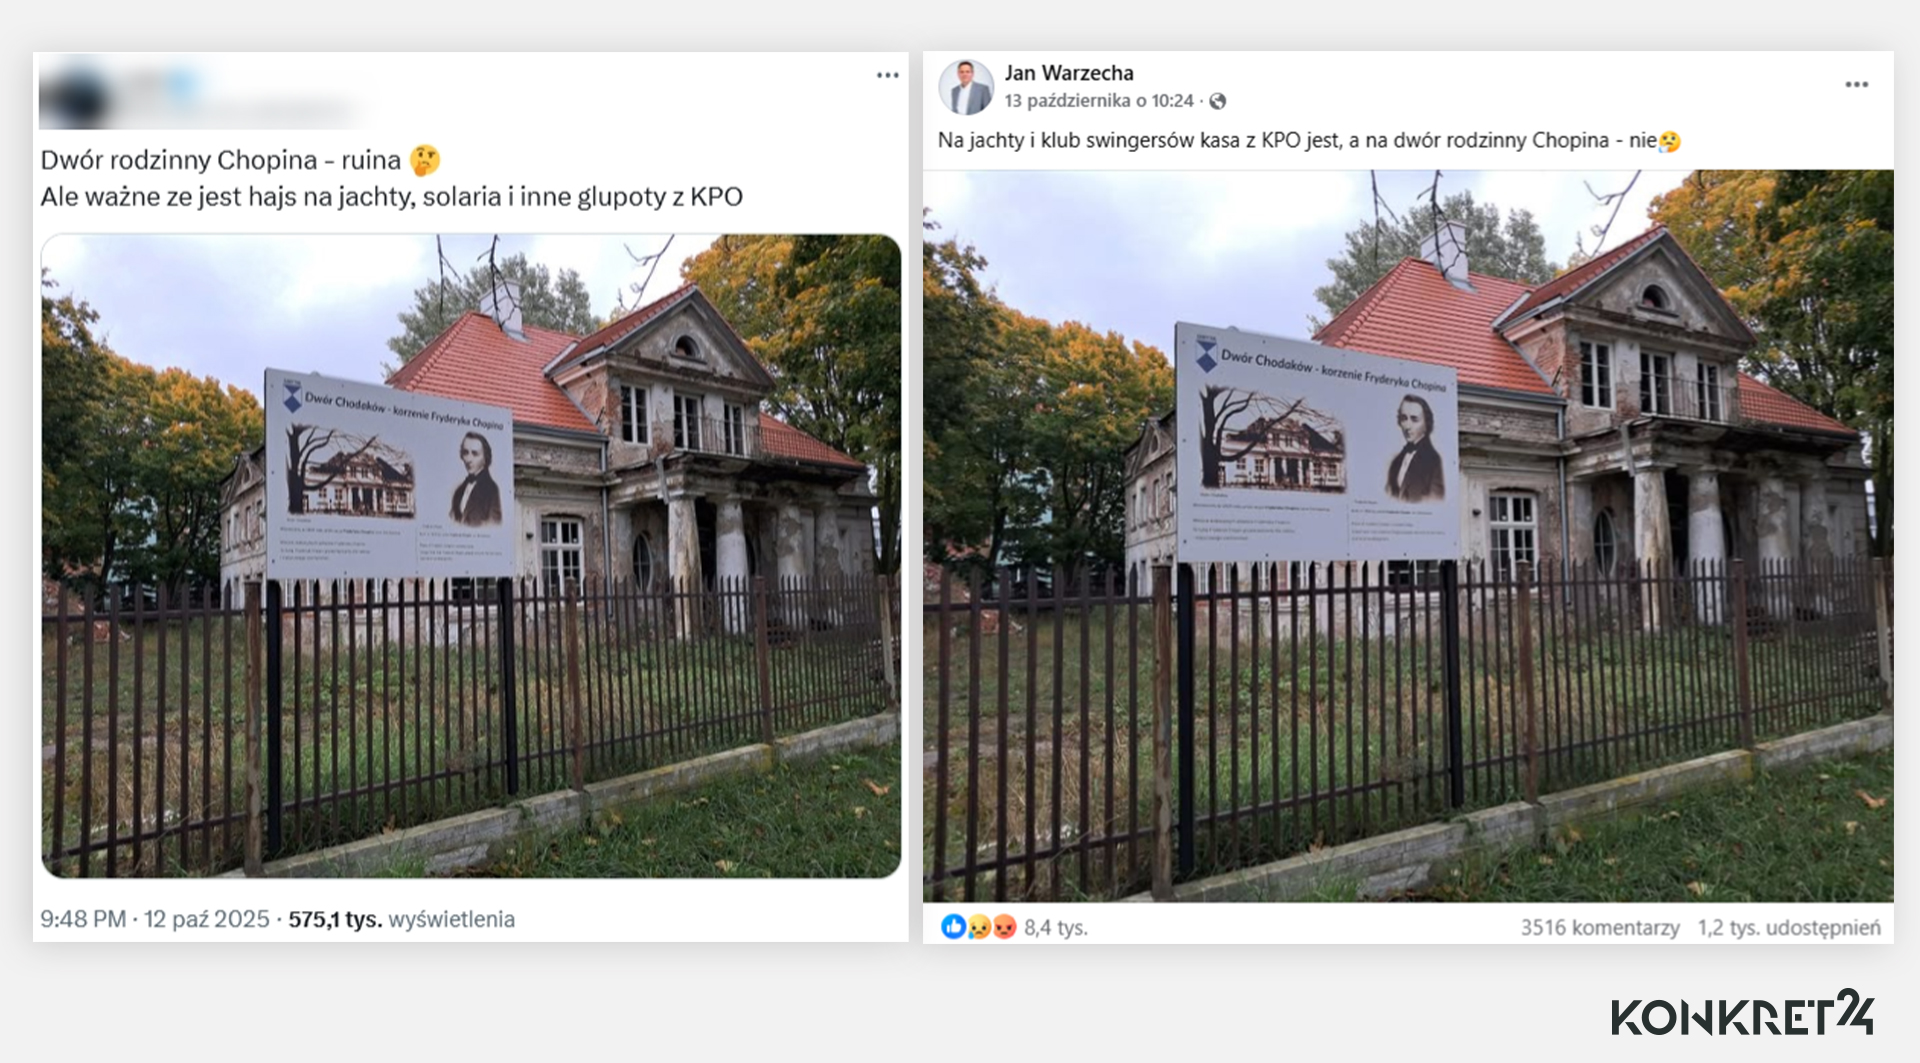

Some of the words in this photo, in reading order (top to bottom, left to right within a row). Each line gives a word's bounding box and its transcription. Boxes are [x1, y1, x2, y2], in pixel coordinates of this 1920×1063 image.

[1005, 64, 1035, 81] Jan
[1042, 64, 1134, 81] Warzecha
[1005, 94, 1022, 107] 13
[1028, 93, 1130, 111] października
[1136, 97, 1147, 107] o
[1152, 94, 1194, 107] 10:24
[939, 131, 966, 148] Na
[970, 131, 1025, 152] jachty
[1031, 131, 1034, 148] i
[1042, 131, 1080, 148] klub
[1086, 131, 1195, 152] swingersów
[1201, 131, 1239, 148] kasa
[1246, 135, 1256, 148] z
[1263, 131, 1303, 148] KPO
[1306, 131, 1343, 152] jest,
[1349, 135, 1359, 148] a
[1366, 135, 1387, 148] na
[1394, 131, 1441, 148] dwór
[1447, 131, 1527, 152] rodzinny
[1533, 131, 1609, 152] Chopina
[1630, 131, 1657, 148] nie
[42, 148, 104, 170] Dwór
[111, 148, 211, 174] rodzinny
[218, 148, 317, 174] Chopina
[343, 148, 401, 170] ruina
[40, 185, 79, 206] Ale
[85, 185, 160, 206] ważne
[167, 191, 192, 206] ze
[197, 185, 241, 211] jest
[250, 185, 297, 211] hajs
[305, 191, 332, 206] na
[337, 185, 416, 211] jachty,
[423, 185, 501, 206] solaria
[509, 185, 513, 206] i
[521, 185, 571, 206] inne
[578, 185, 667, 211] glupoty
[673, 191, 684, 206] z
[692, 186, 743, 206] KPO
[1221, 349, 1252, 364] Dwór
[1256, 354, 1312, 373] Chodaków
[1321, 365, 1362, 381] korzenie
[1365, 372, 1408, 387] Fryderyka
[1411, 379, 1446, 393] Chopina
[305, 392, 332, 406] Dwór
[335, 396, 385, 413] Chodaków
[393, 406, 429, 419] korzenie
[431, 411, 470, 426] Fryderyka
[472, 418, 503, 431] Chopina
[41, 910, 87, 928] 9:48
[94, 910, 126, 927] PM
[144, 910, 165, 928] 12
[173, 910, 209, 932] paź
[215, 910, 269, 928] 2025
[289, 911, 339, 931] 575,1
[345, 911, 382, 932] tys.
[389, 910, 515, 932] wyświetlenia
[1025, 919, 1051, 938] 8,4
[1058, 921, 1087, 940] tys.
[1522, 919, 1566, 936] 3516
[1573, 919, 1680, 940] komentarzy
[1699, 919, 1723, 937] 1,2
[1730, 921, 1760, 940] tys.
[1767, 919, 1881, 939] udostępnień
